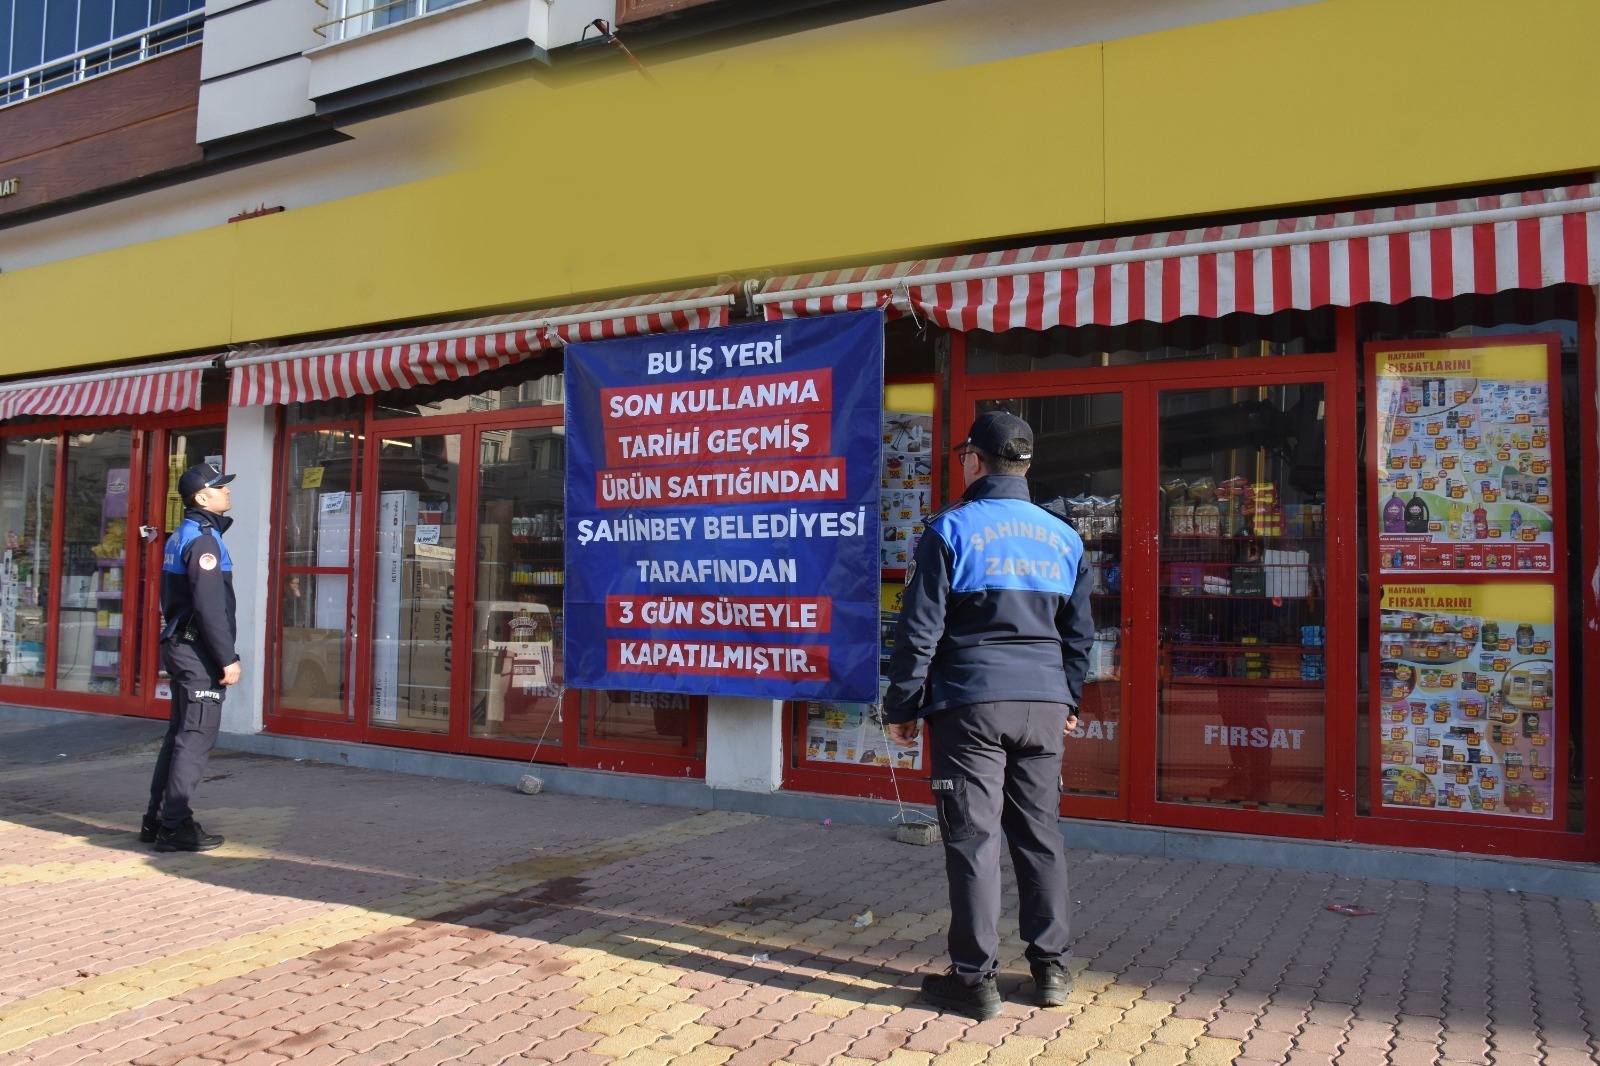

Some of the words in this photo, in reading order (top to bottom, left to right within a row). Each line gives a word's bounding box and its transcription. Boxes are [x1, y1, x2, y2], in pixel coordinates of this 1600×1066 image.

[647, 350, 683, 375] BU
[690, 343, 714, 374] İŞ
[720, 334, 783, 369] YERİ
[1388, 352, 1425, 361] HAFTANIN
[609, 392, 663, 419] SON
[669, 379, 819, 413] KULLANMA
[618, 426, 700, 459] TARİHİ
[706, 419, 811, 456] GEÇMİŞ
[602, 474, 662, 502] ÜRÜN
[667, 467, 839, 499] SATTIĞINDAN
[577, 514, 697, 546] ŞAHİNBEY
[704, 505, 867, 540] BELEDİYESİ
[969, 517, 1072, 557] ŞAHİNBEY
[636, 558, 797, 584] TARAFINDAN
[985, 557, 1061, 581] ZABITA
[618, 601, 634, 624] 3
[640, 597, 694, 625] GÜN
[699, 597, 818, 628] SÜREYLE
[619, 642, 817, 676] KAPATILMIŞTIR.
[522, 681, 563, 698] FIRS
[1068, 720, 1119, 741] SAT
[1204, 724, 1305, 750] FIRSAT
